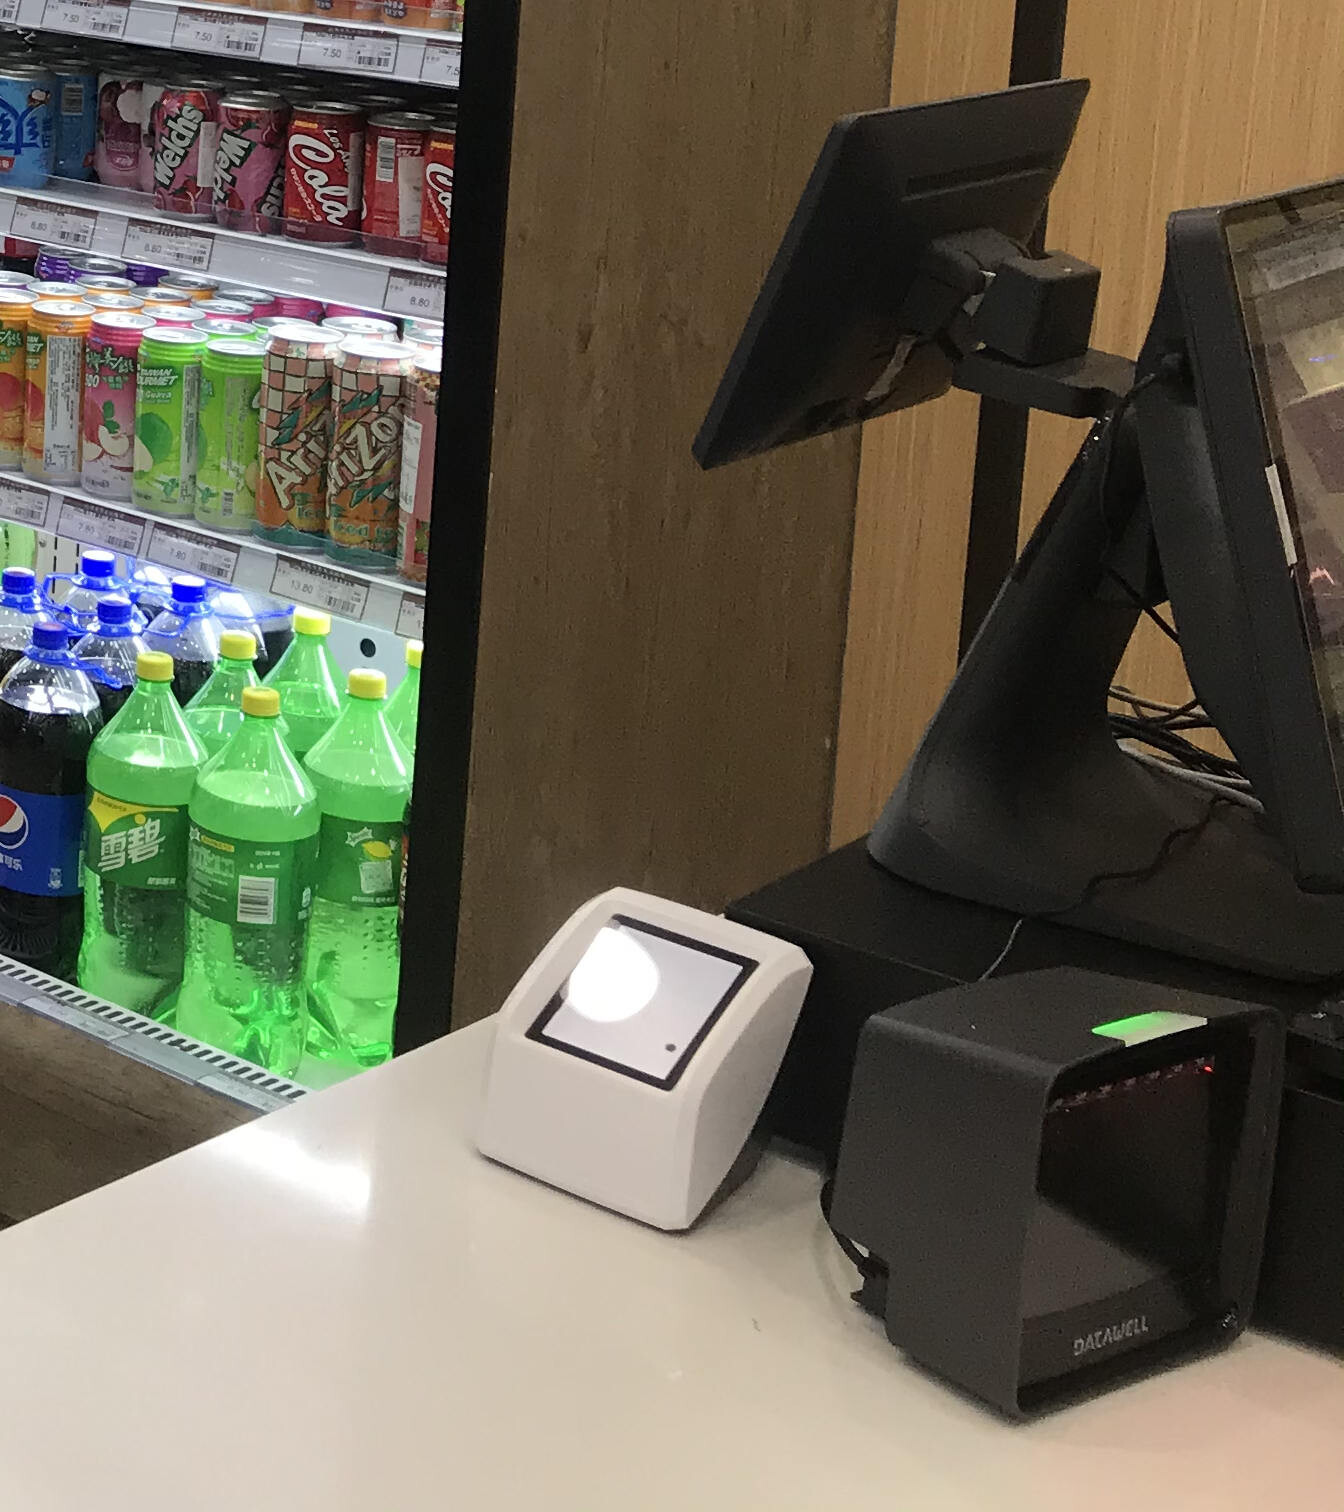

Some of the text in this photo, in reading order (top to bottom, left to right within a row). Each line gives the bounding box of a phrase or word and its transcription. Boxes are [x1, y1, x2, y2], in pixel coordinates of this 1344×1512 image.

[288, 133, 349, 227] Cola
[97, 817, 168, 873] 雪碧
[1072, 1313, 1150, 1357] DATAWELL
